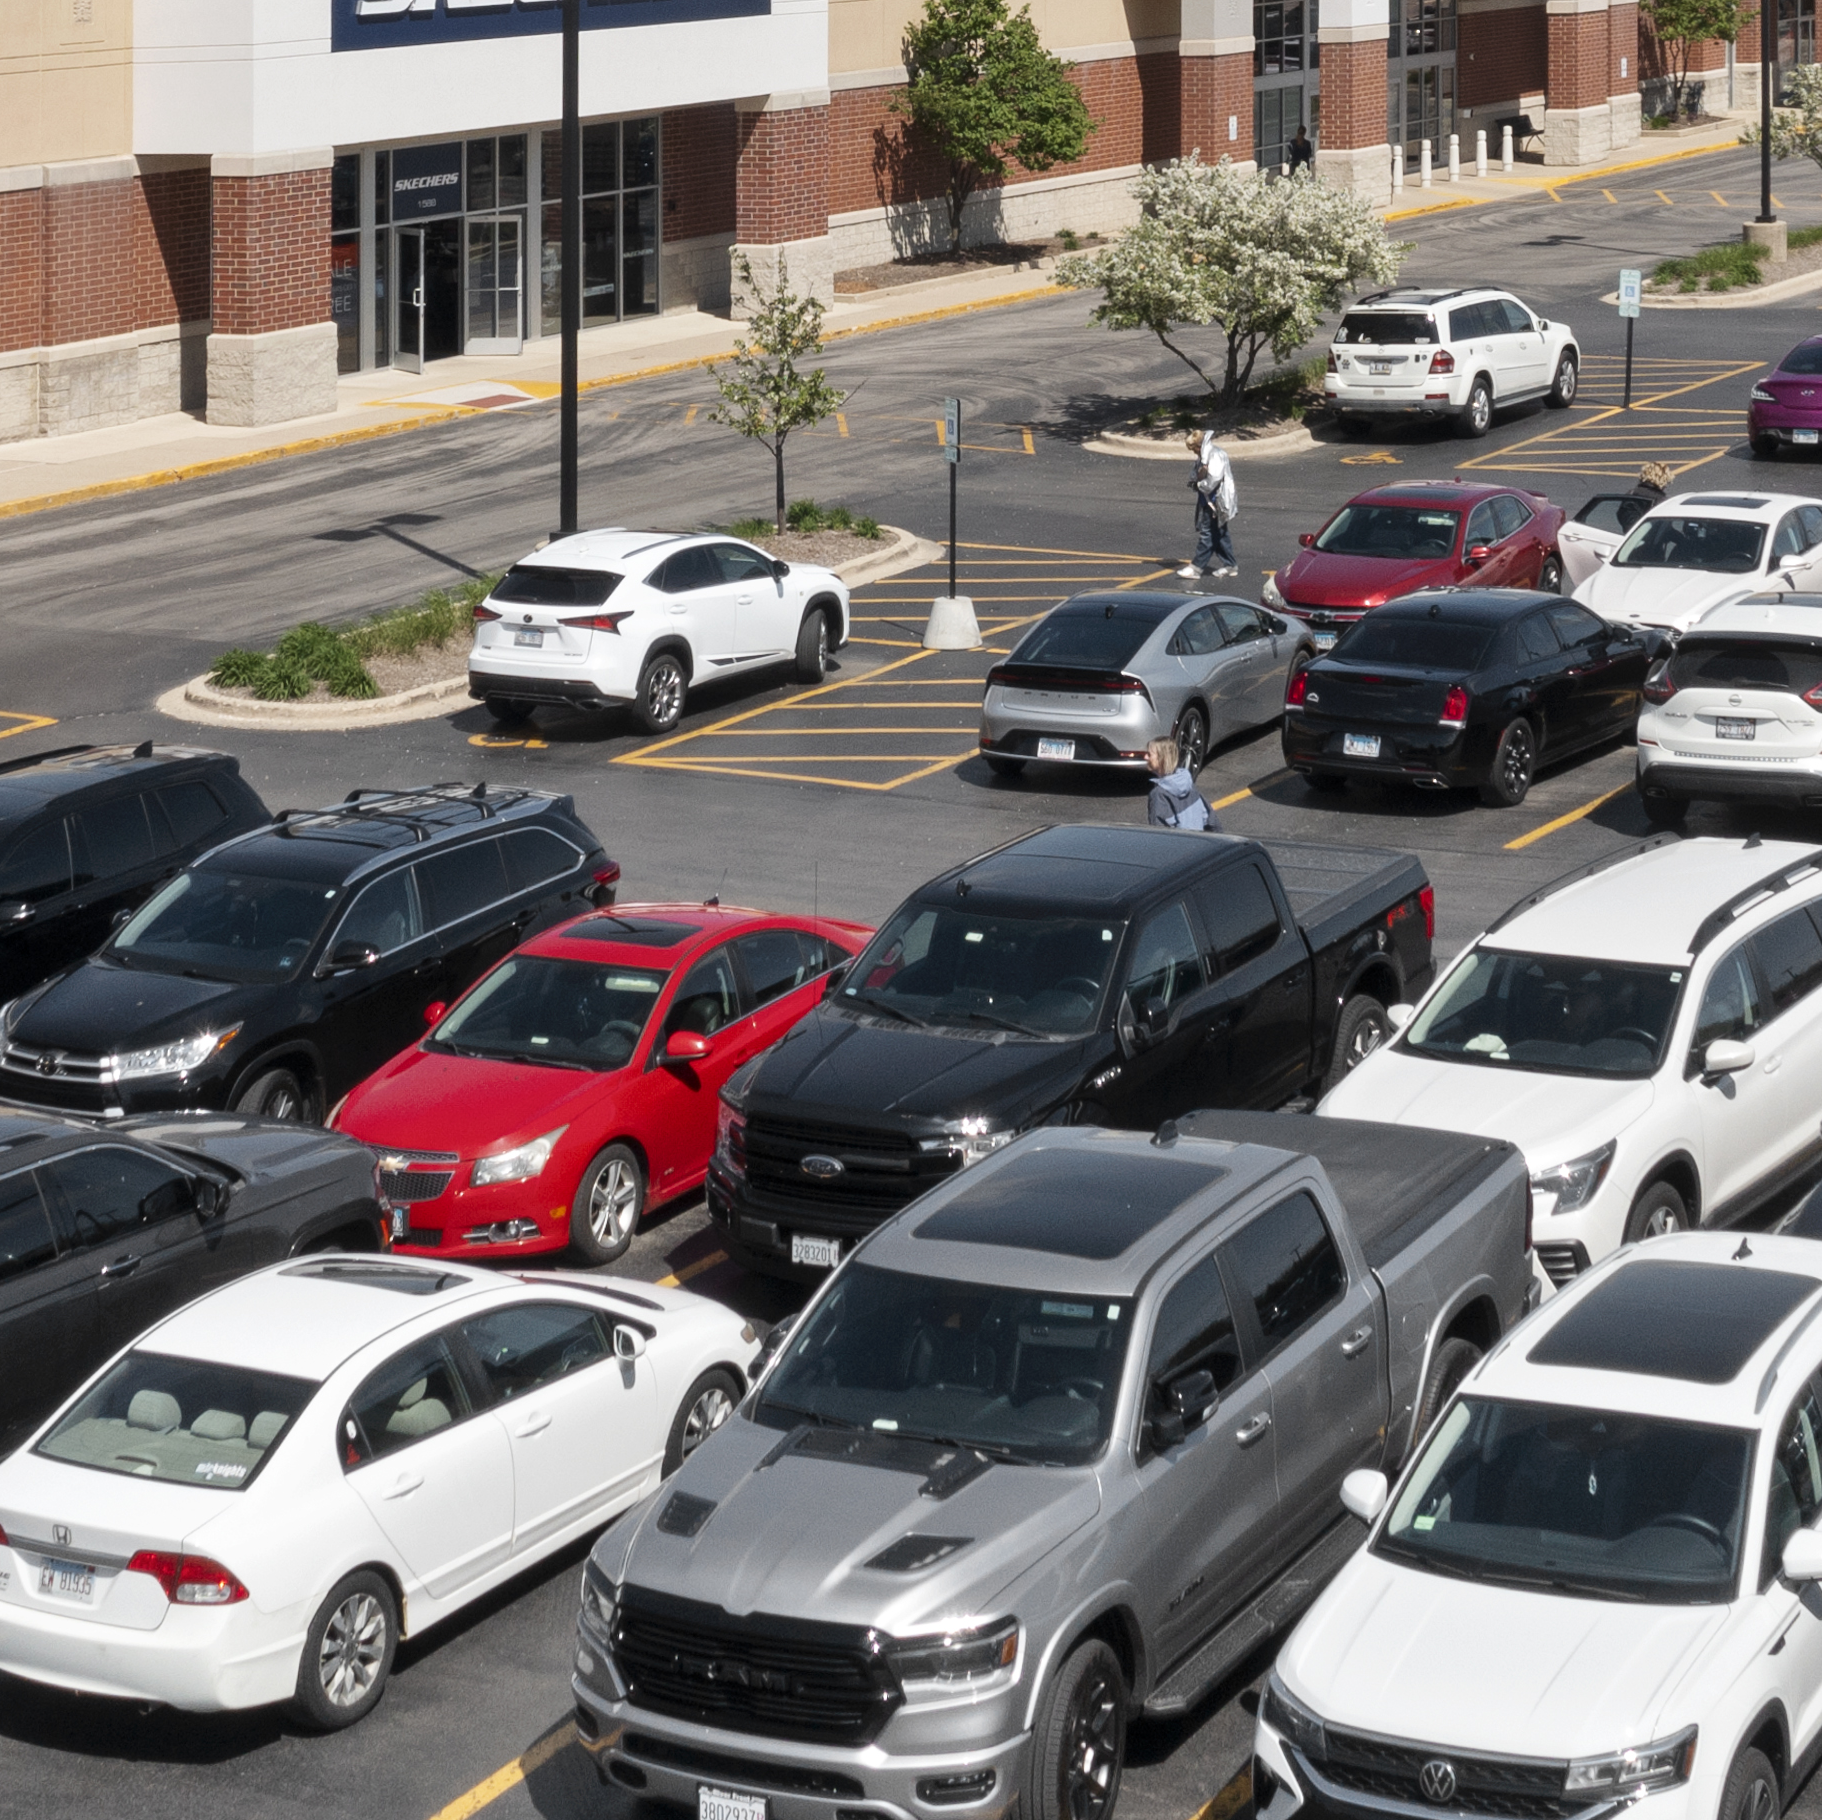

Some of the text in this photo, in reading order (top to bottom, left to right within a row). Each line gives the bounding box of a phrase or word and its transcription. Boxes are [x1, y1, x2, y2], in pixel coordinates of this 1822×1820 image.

[394, 172, 459, 192] SKECHERS
[793, 1242, 831, 1263] 3283201
[59, 1571, 93, 1595] 81935
